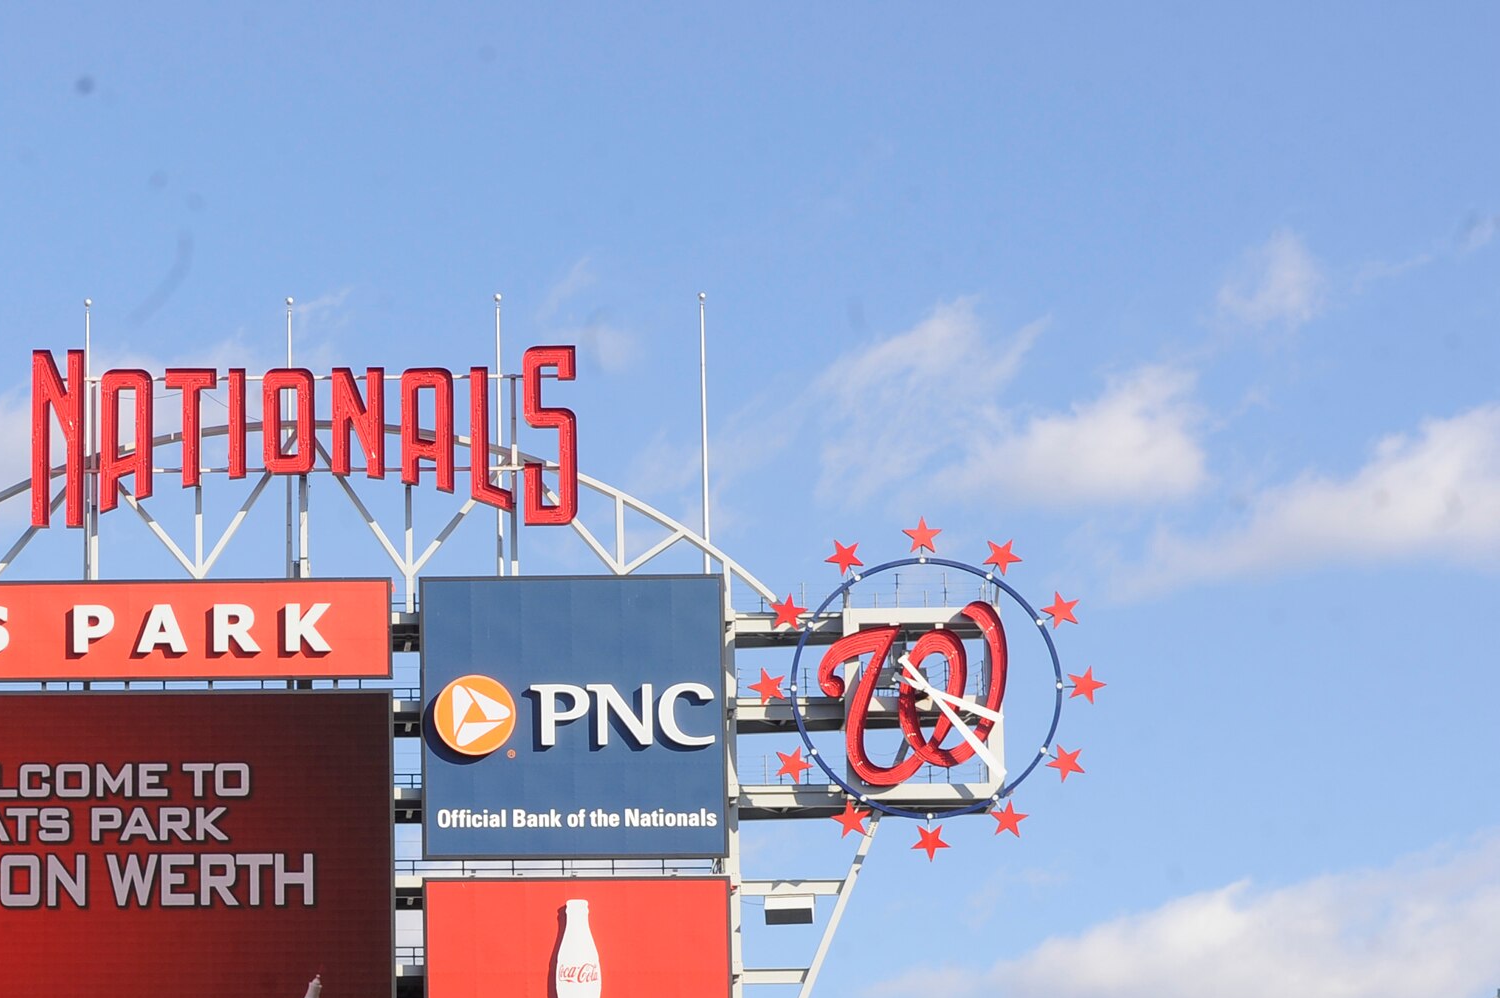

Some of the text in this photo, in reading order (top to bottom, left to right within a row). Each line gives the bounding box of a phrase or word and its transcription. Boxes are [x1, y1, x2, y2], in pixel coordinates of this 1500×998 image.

[31, 345, 578, 528] NATIONALS
[71, 603, 333, 654] PARK
[529, 682, 716, 746] PNC
[182, 762, 251, 798] TO
[90, 805, 230, 842] PARK
[437, 807, 718, 828] Official Bank of the Nationals
[105, 853, 315, 907] WERTH
